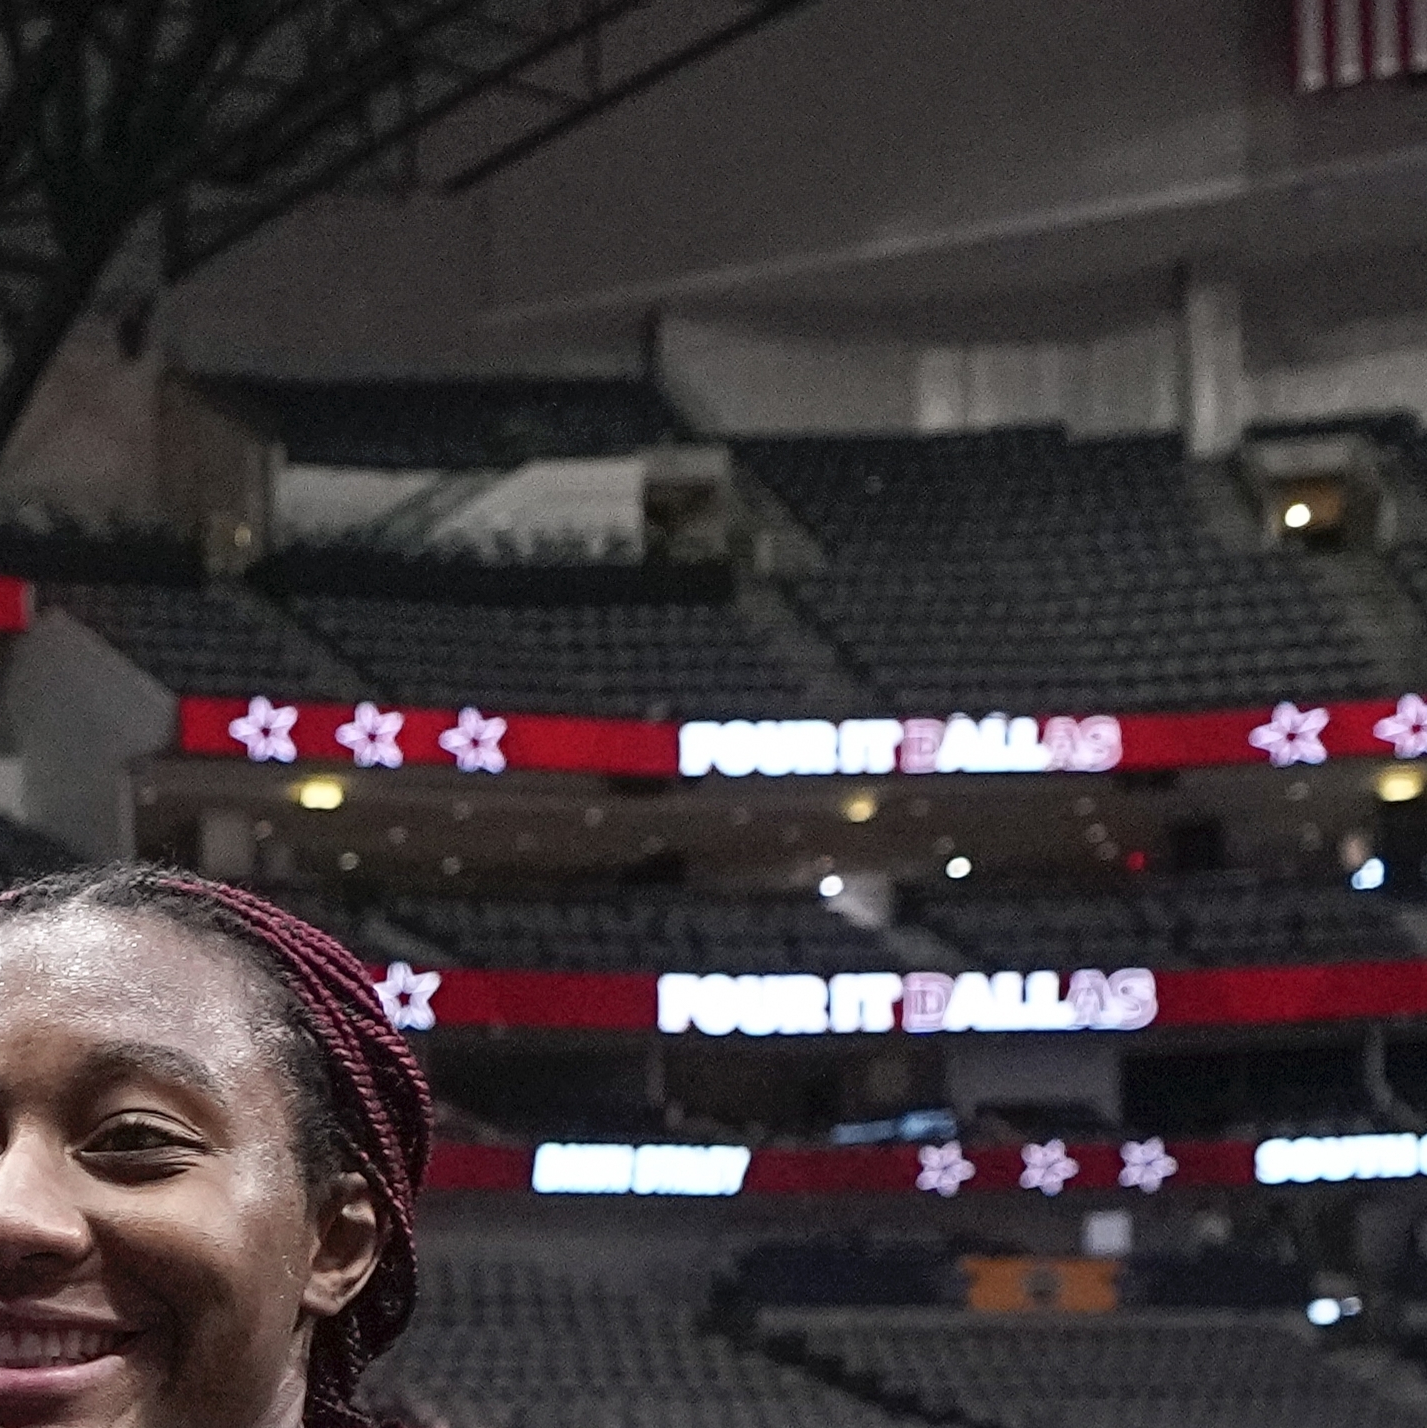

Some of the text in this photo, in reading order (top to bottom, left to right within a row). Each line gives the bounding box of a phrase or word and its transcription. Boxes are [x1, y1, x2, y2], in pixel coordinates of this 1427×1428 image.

[678, 718, 838, 777] FOUR
[657, 971, 830, 1035] FOUR
[902, 967, 1159, 1032] DALLAS
